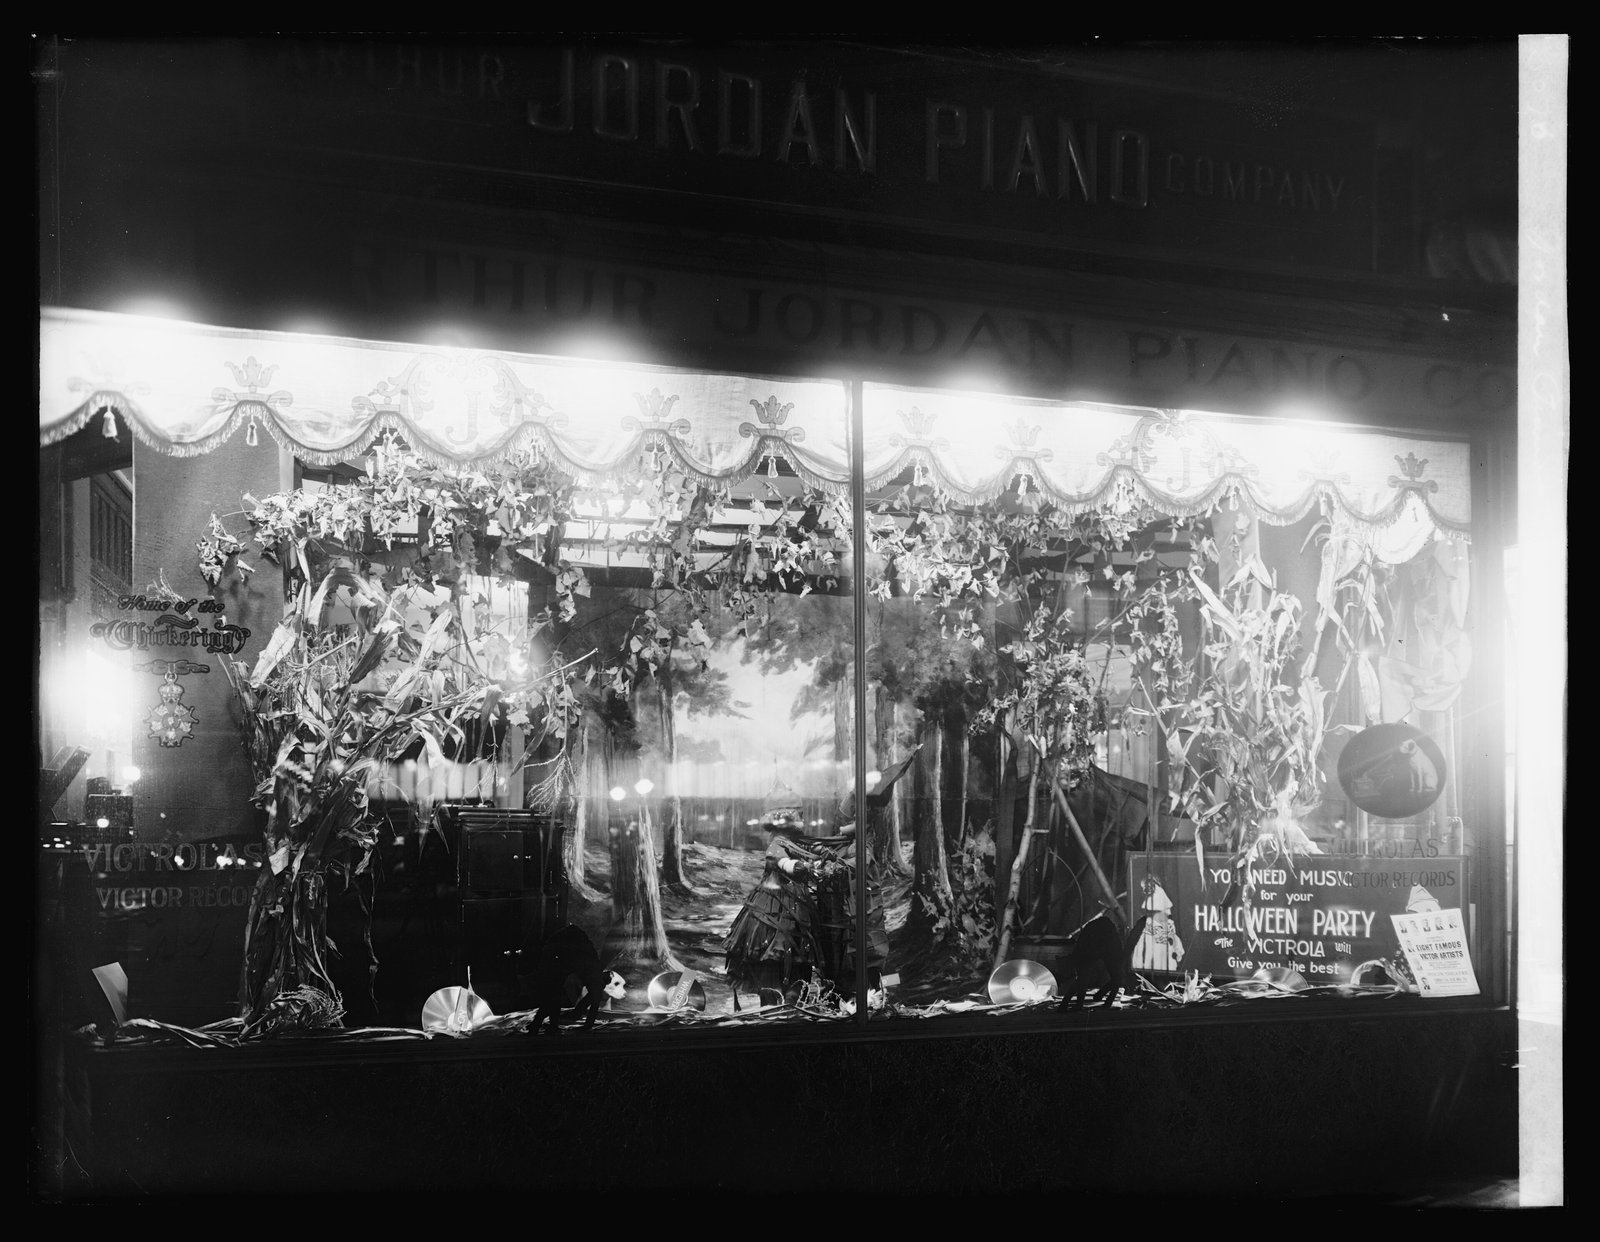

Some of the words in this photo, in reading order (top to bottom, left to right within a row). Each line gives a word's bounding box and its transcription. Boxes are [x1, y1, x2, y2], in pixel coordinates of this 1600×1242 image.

[526, 47, 877, 174] JORDAN
[925, 98, 1150, 210] PIANO
[1165, 152, 1346, 213] COMPANY
[348, 243, 664, 330] RTHUR
[713, 287, 1075, 382] JORDAN
[1124, 330, 1376, 402] PIANO
[117, 594, 171, 612] Home
[174, 598, 198, 614] of
[198, 598, 226, 613] the
[89, 614, 252, 655] Chickering
[81, 842, 263, 871] VICTROLAS
[1327, 837, 1439, 860] VROLAS
[1210, 868, 1240, 884] YO
[1253, 868, 1287, 885] NEED
[1392, 870, 1456, 888] RECORDS
[96, 887, 183, 910] VICTOR
[1260, 889, 1278, 902] for
[1286, 893, 1314, 905] your
[1194, 904, 1298, 935] HALLOWEEN
[1313, 908, 1376, 938] PARTY
[1213, 937, 1234, 949] The
[1247, 938, 1326, 959] VICTROLA
[1334, 942, 1353, 955] will
[1419, 952, 1439, 960] VICTOR
[1439, 950, 1464, 960] ARTISTS
[1435, 940, 1462, 951] FAMOUS
[1227, 957, 1254, 970] Give
[1288, 960, 1306, 973] the
[1310, 961, 1340, 975] best
